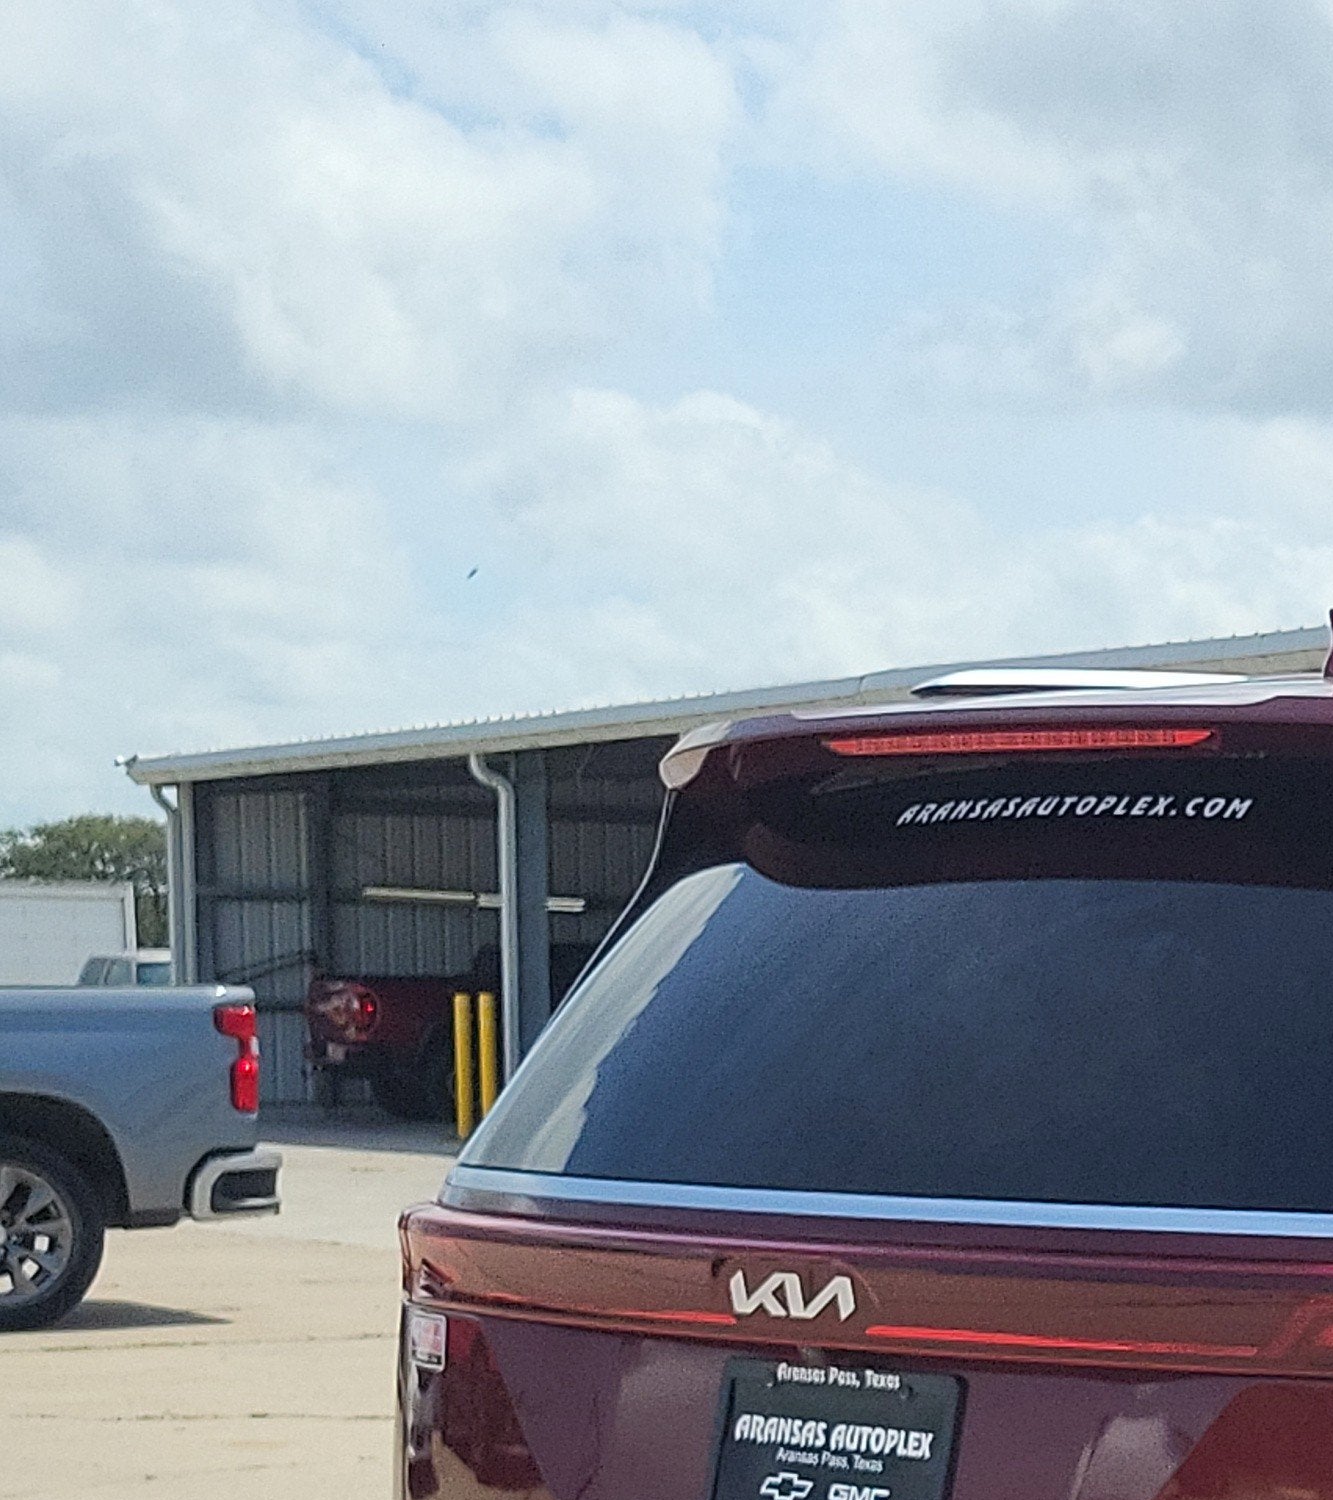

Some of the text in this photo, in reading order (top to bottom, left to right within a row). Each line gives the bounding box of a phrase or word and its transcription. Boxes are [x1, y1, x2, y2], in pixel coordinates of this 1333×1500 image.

[896, 795, 1253, 826] ARANSASAUTOPLEX.COM
[730, 1268, 856, 1322] KIA
[864, 1369, 900, 1390] Texas
[735, 1414, 934, 1460] ARANSAS AUTOPLEX
[776, 1447, 819, 1466] Aransas
[852, 1454, 884, 1474] Texas
